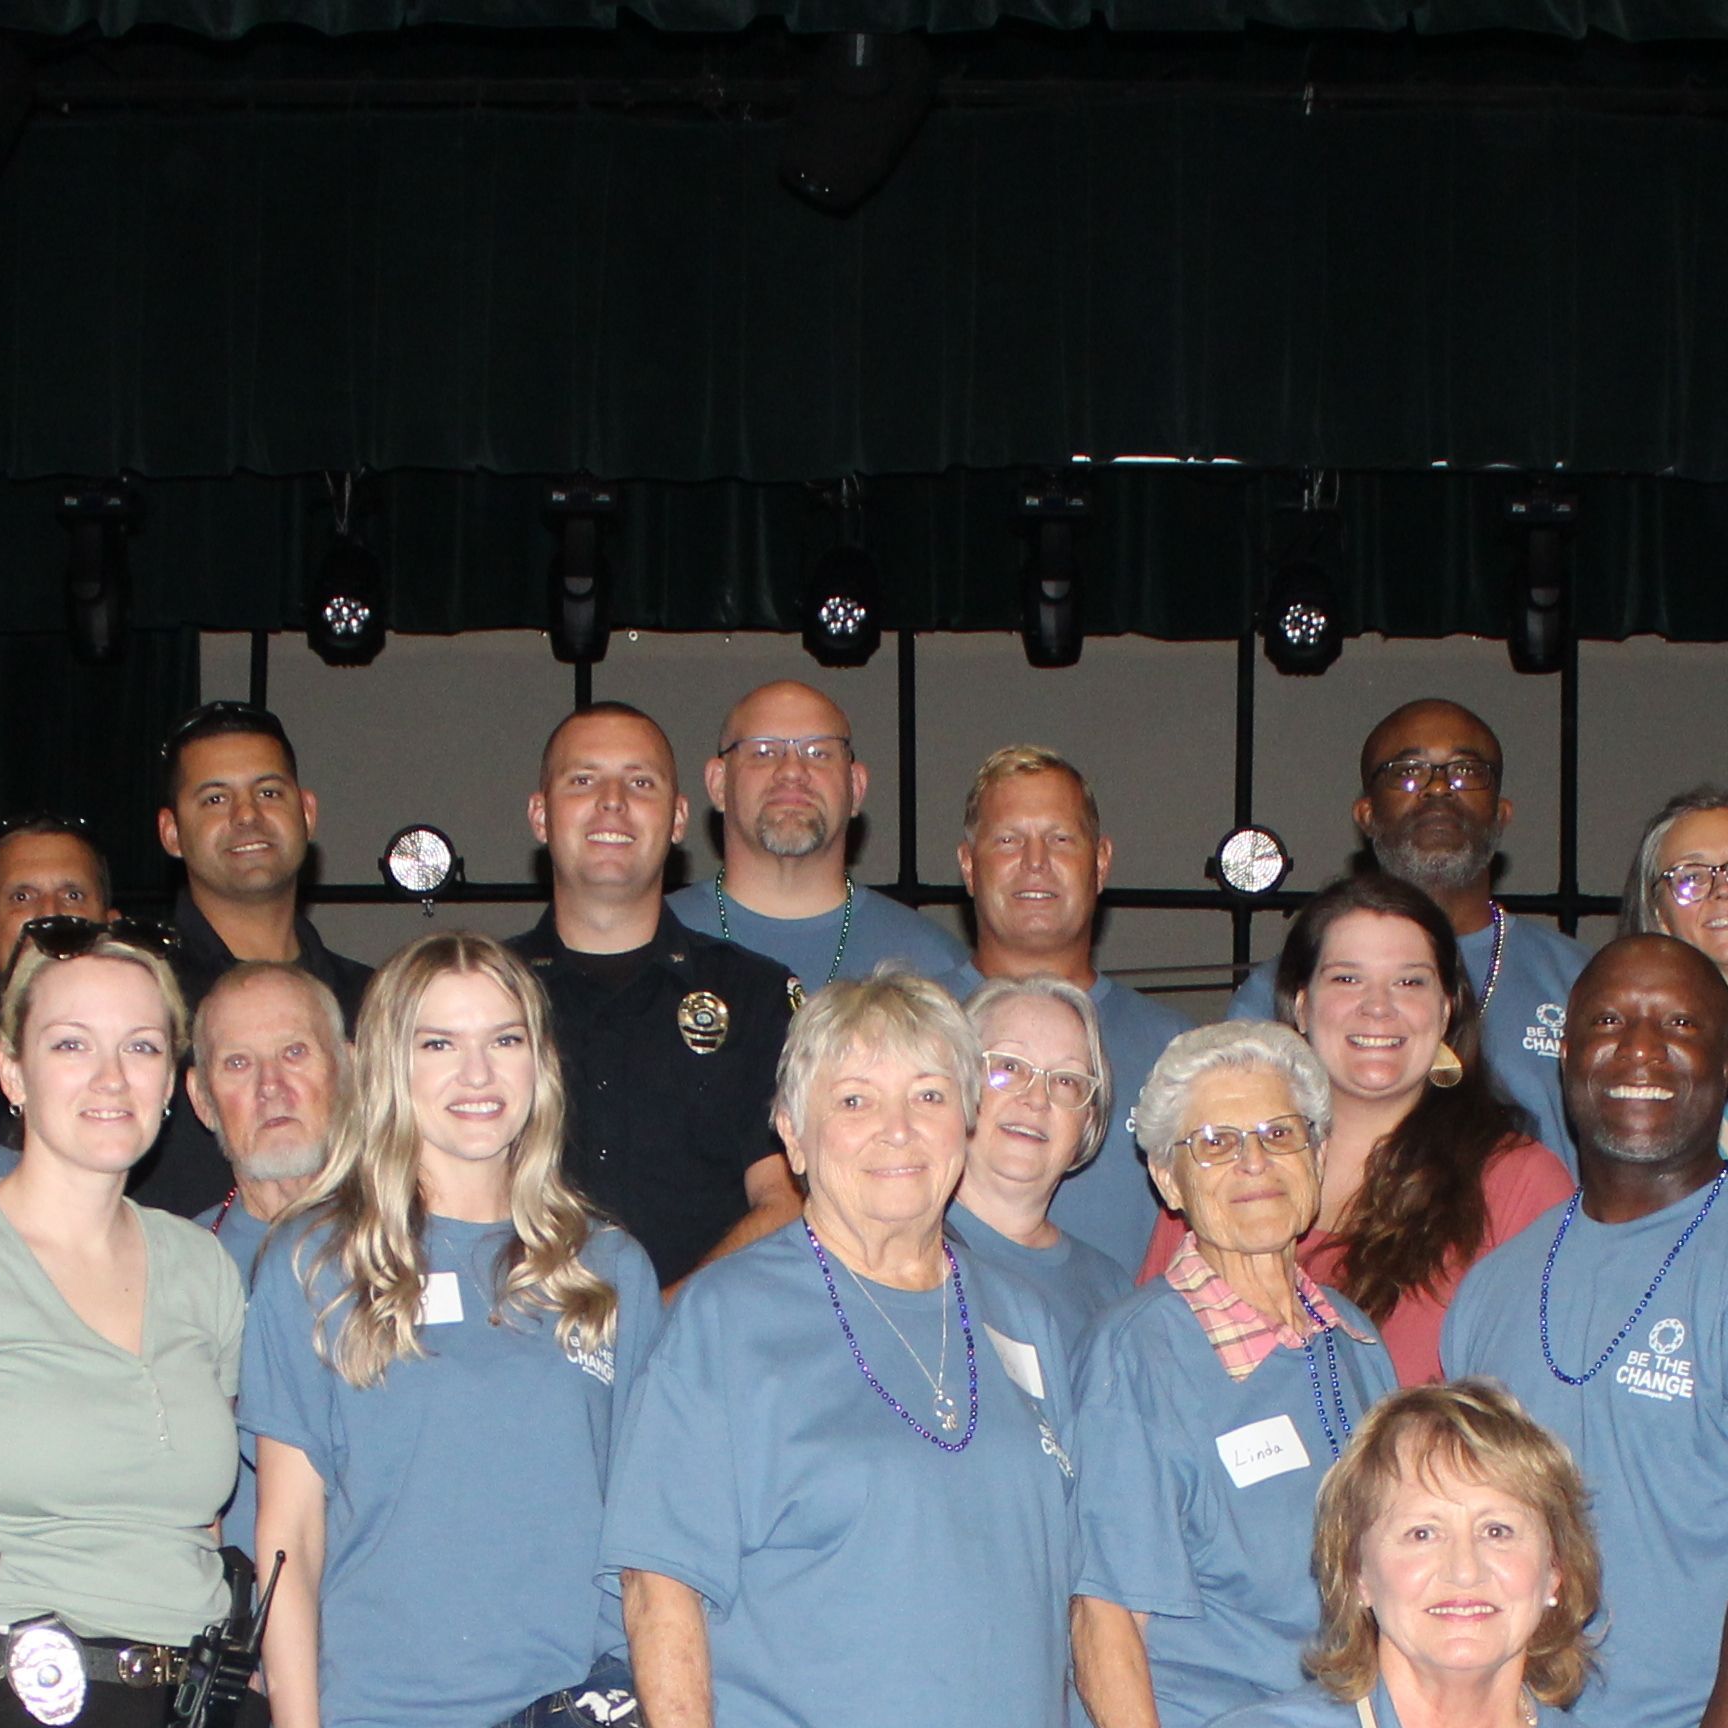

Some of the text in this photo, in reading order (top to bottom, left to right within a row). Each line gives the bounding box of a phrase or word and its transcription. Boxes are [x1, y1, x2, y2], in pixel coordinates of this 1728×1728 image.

[1526, 1026, 1548, 1037] BE
[1626, 1350, 1691, 1376] BE THE
[1615, 1365, 1694, 1398] CHANGE
[1235, 1440, 1284, 1467] Linda
